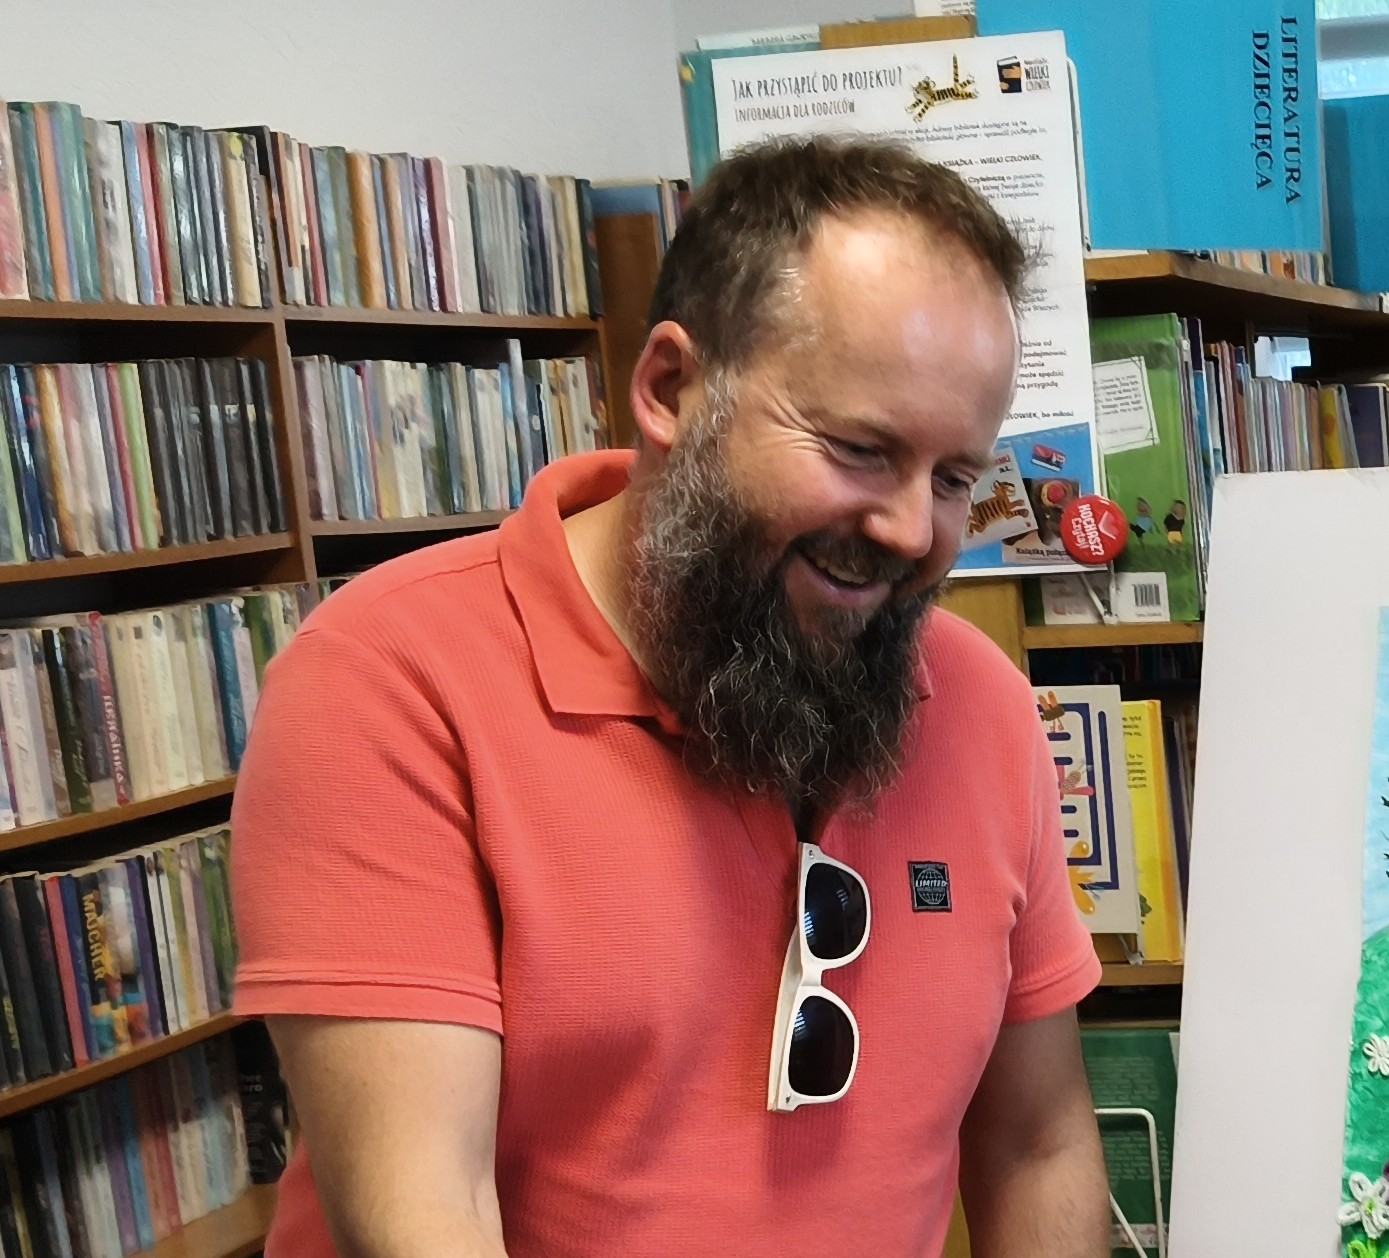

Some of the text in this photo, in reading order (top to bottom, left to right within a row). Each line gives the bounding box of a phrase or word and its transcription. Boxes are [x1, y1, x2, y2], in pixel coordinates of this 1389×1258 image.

[757, 70, 818, 98] PRZYSTĄPIĆ
[822, 73, 838, 92] DO
[842, 66, 903, 90] PROJEKTU?
[735, 97, 855, 122] INFORMACJA DLA RODZICÓW
[1250, 30, 1273, 190] DZIECIĘCA
[1280, 16, 1302, 205] LITERATURA
[1078, 503, 1104, 556] KOCHASZ?
